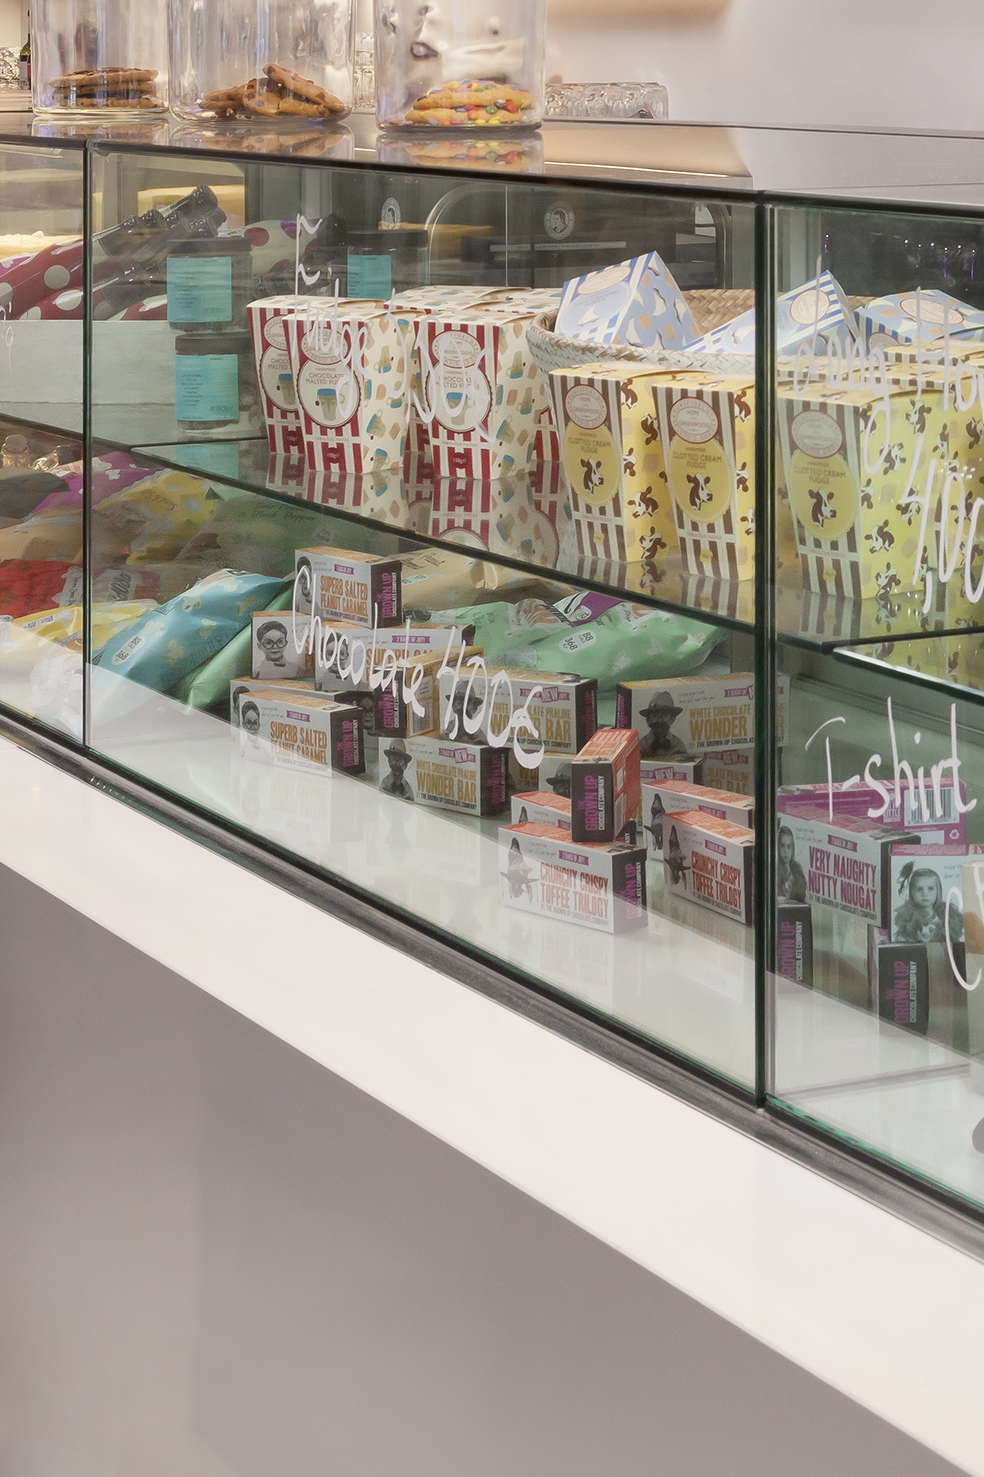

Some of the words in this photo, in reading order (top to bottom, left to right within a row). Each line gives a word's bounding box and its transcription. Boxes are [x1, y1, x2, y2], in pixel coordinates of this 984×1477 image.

[673, 452, 699, 461] CLOTTED
[701, 454, 721, 462] CREAM
[687, 461, 706, 469] FUDGE
[565, 637, 578, 651] 368
[690, 707, 711, 719] WHITE
[713, 704, 751, 717] CHOCOLATE
[270, 721, 298, 743] SUPERB
[300, 726, 327, 749] SALTED
[545, 717, 571, 742] BAR
[690, 716, 748, 741] WONDER
[805, 696, 978, 822] T-shirt
[416, 770, 455, 799] WONDER
[457, 780, 476, 803] BAR
[585, 775, 598, 789] UP
[585, 792, 598, 831] GROWN
[540, 861, 577, 889] CRUNCHY
[580, 872, 608, 897] CRISPY
[692, 851, 718, 880] CRUNCHY
[720, 861, 741, 889] CRISPY
[809, 846, 831, 874] VERY
[834, 853, 876, 888] NAUGHTY
[541, 882, 570, 910] TOFFEE
[573, 890, 608, 919] TRILOGY
[692, 871, 714, 897] TOFFEE
[715, 878, 741, 909] TRILOGY
[808, 869, 838, 900] NUTTY
[841, 879, 877, 912] NOUGAT
[894, 961, 909, 977] UP
[893, 980, 909, 1023] GROWN
